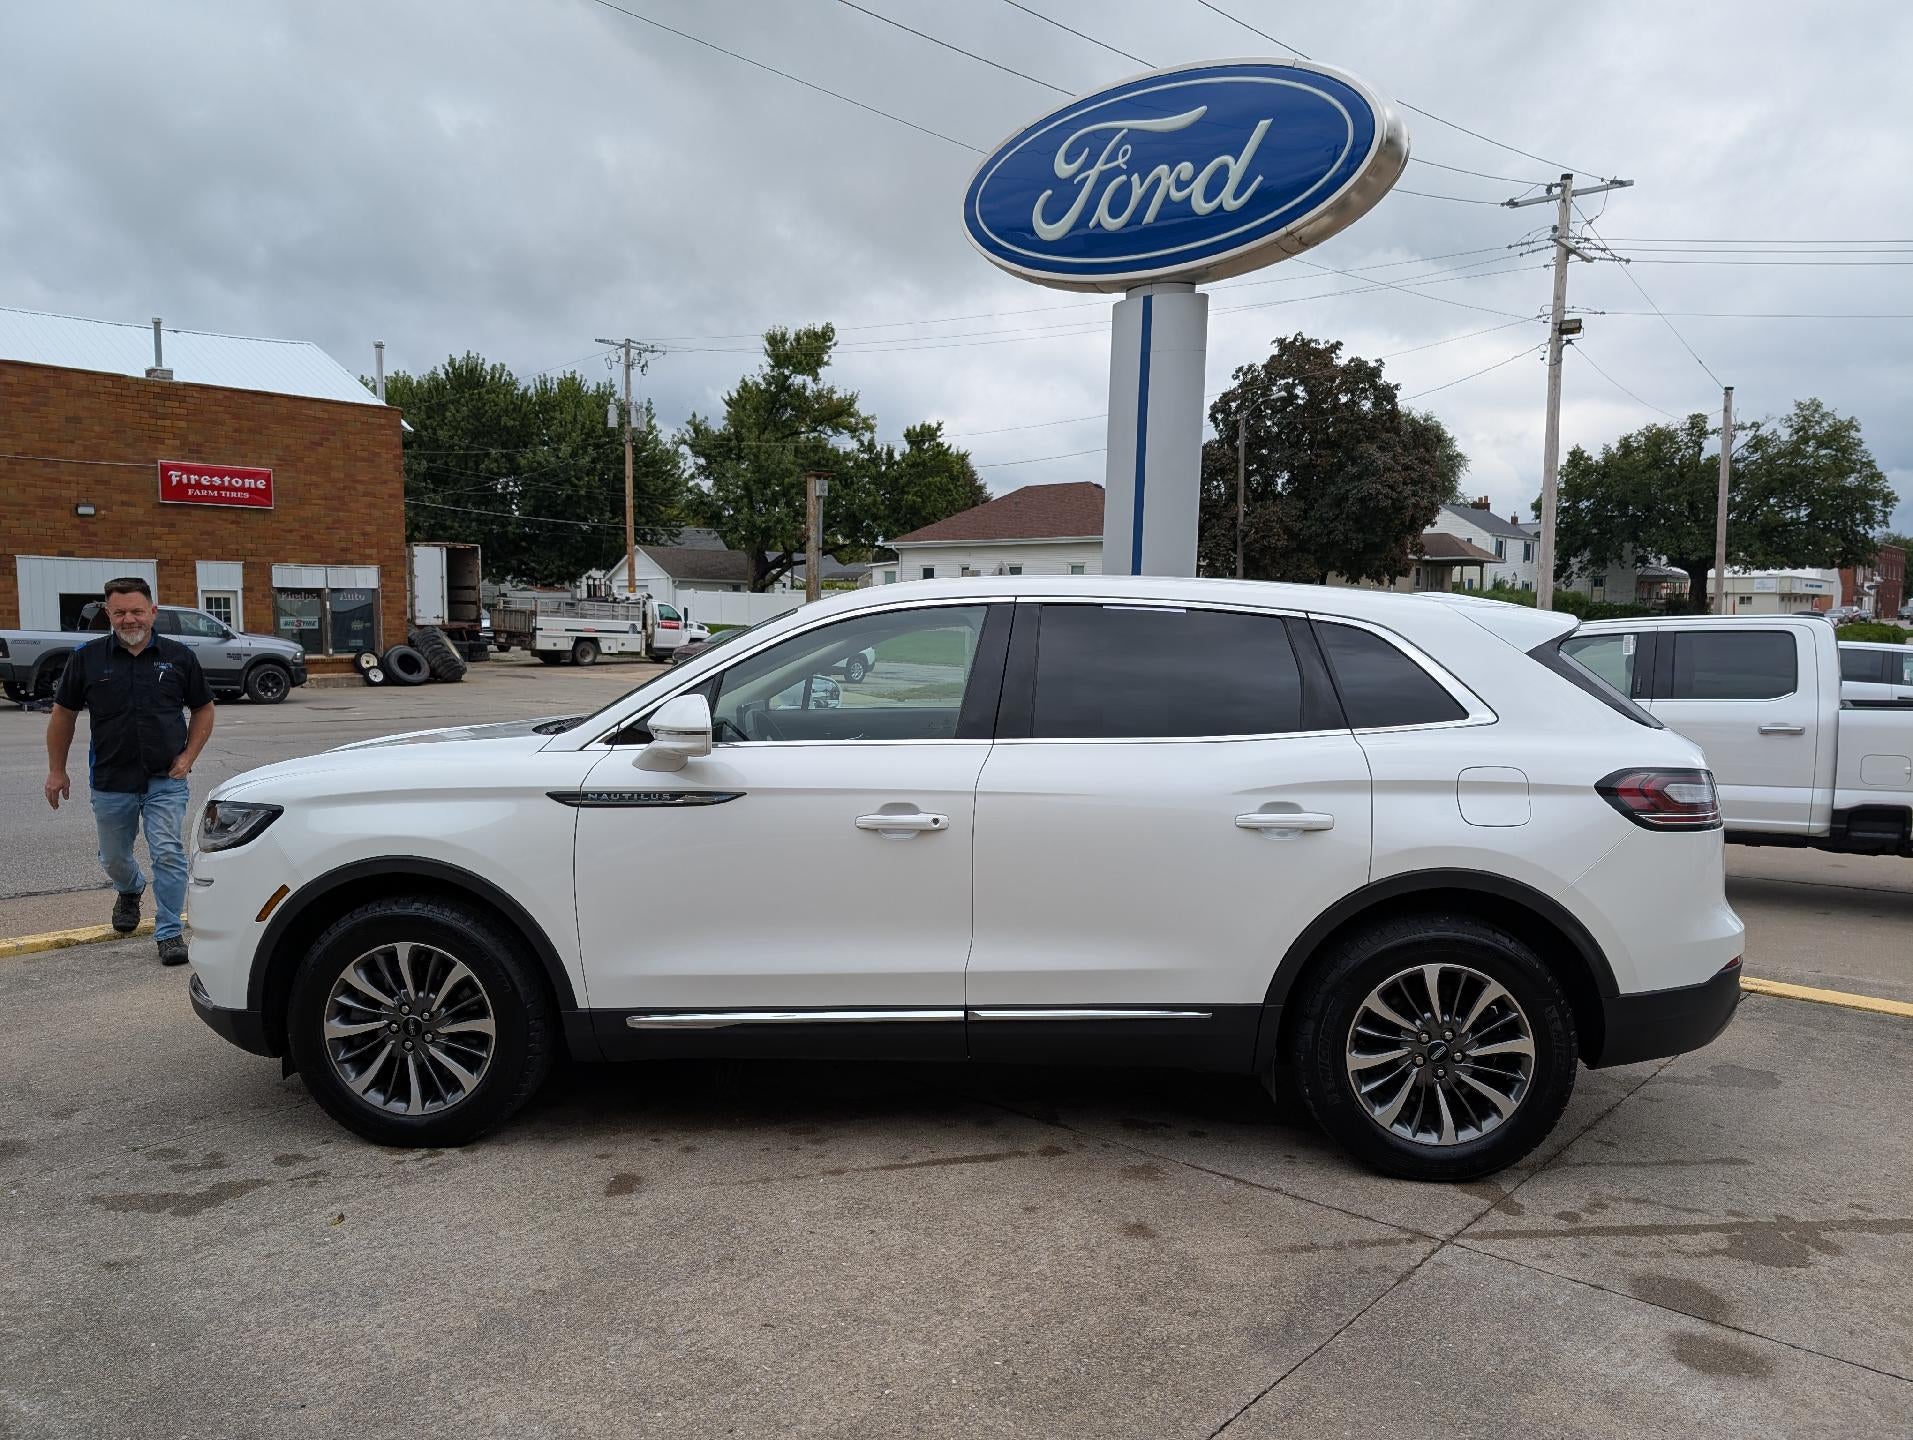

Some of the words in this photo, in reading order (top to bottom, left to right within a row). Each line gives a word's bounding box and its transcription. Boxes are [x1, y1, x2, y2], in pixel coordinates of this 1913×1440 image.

[1032, 105, 1274, 241] Ford
[168, 470, 267, 489] Firestone
[187, 488, 218, 497] FARM
[219, 490, 250, 499] TIRES
[587, 793, 671, 801] NAUTILUS
